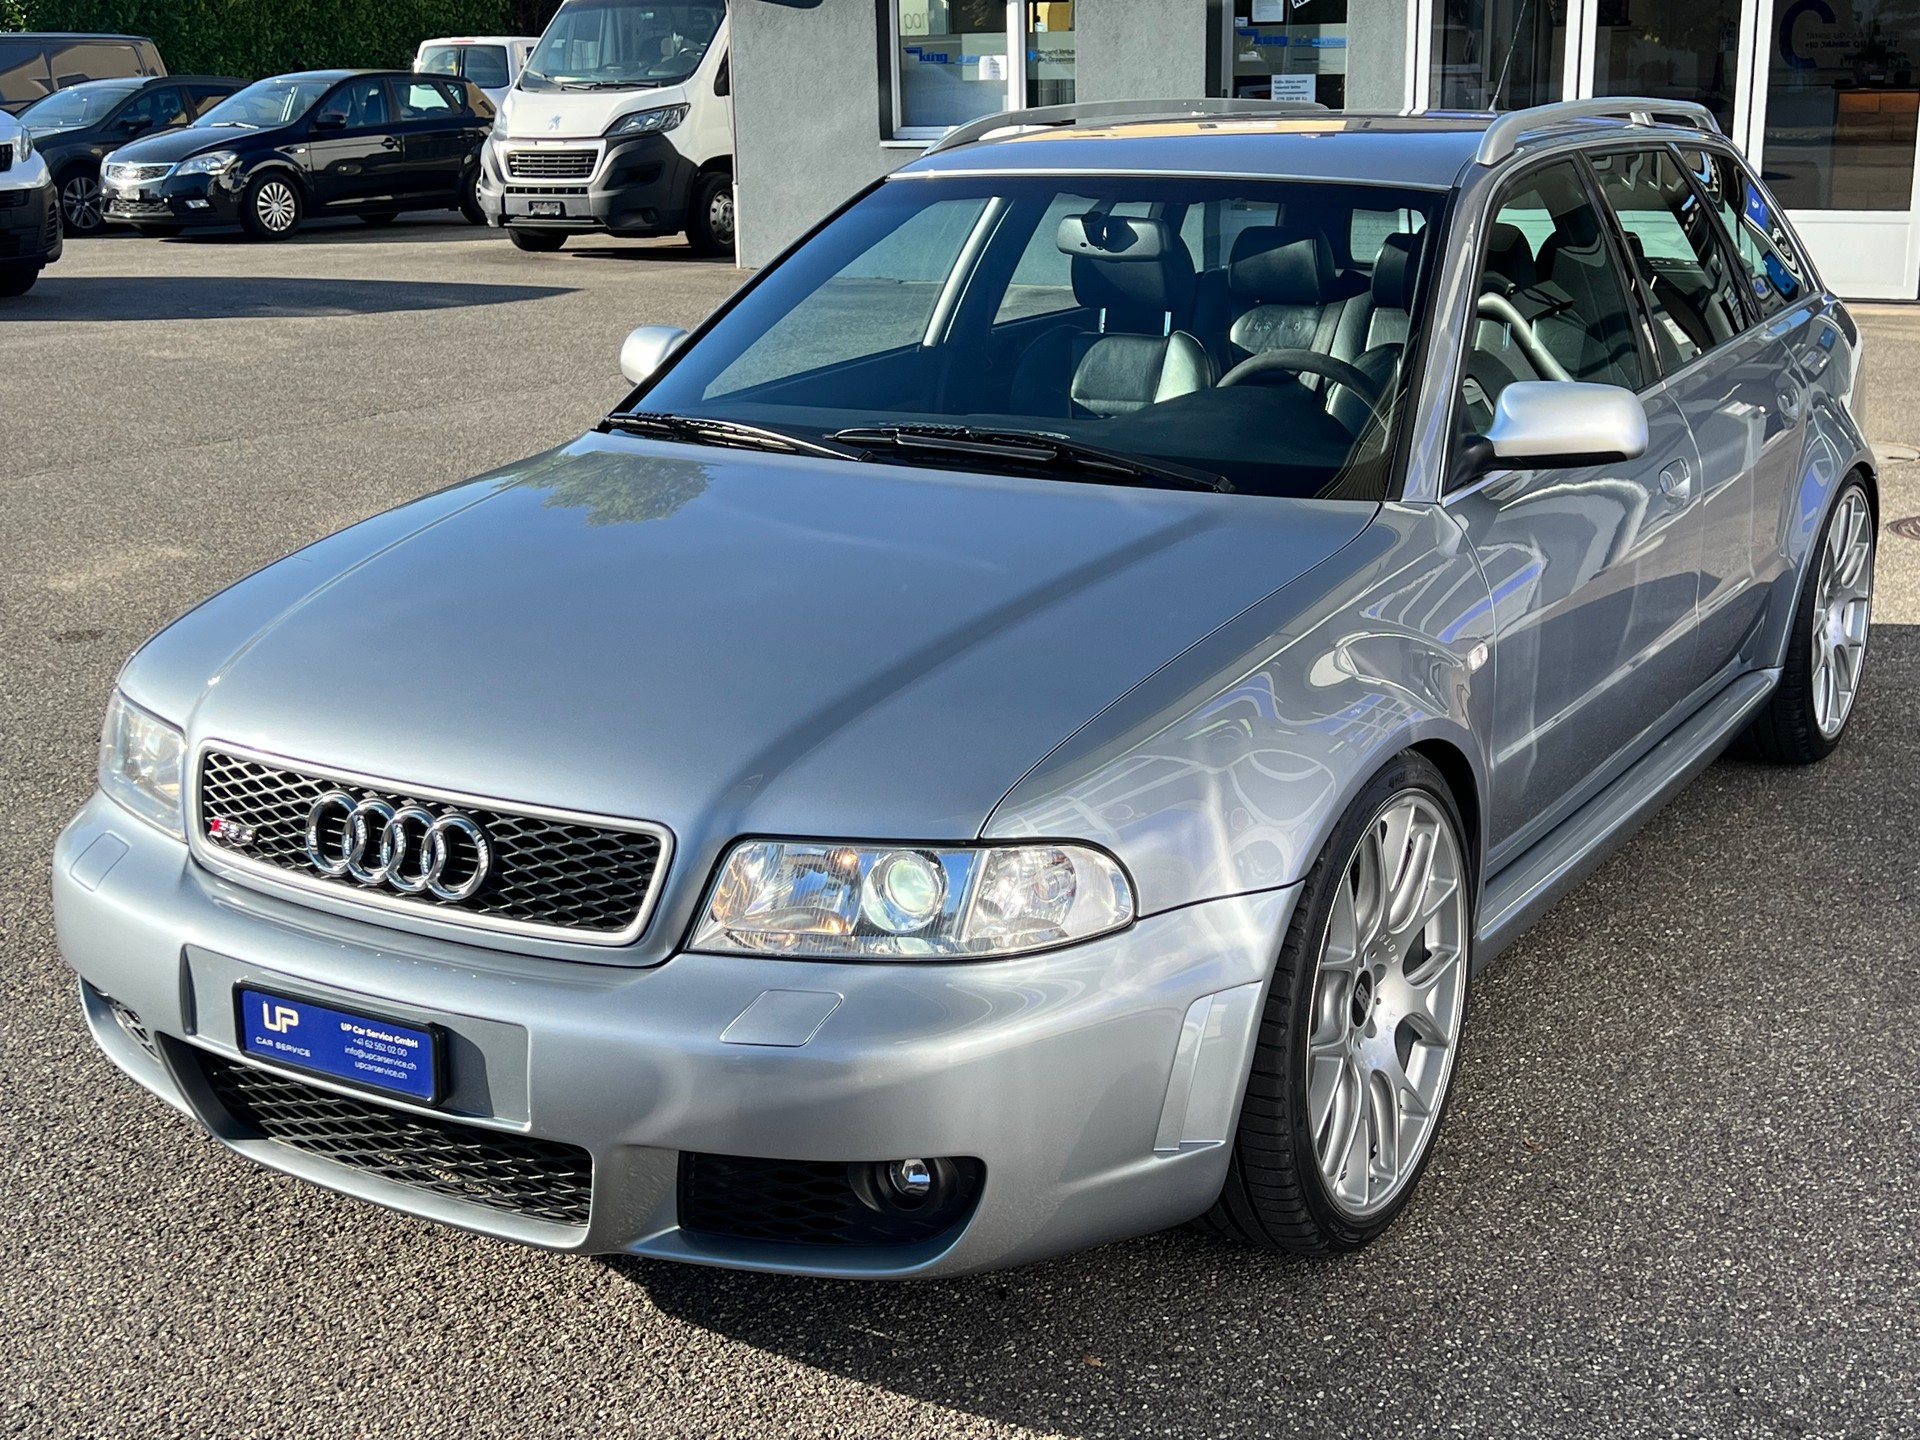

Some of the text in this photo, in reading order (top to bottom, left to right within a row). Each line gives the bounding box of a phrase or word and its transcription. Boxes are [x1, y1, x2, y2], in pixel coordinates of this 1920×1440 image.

[262, 1000, 299, 1034] UP
[255, 1036, 311, 1058] CAR SERVICE
[340, 1021, 419, 1049] UP Car Service GmbH
[344, 1045, 418, 1071] info@upcarservice.ch
[352, 1037, 364, 1047] +41
[364, 1039, 374, 1049] 62
[386, 1044, 397, 1055] 02
[397, 1047, 408, 1058] 00
[354, 1060, 408, 1080] upcarservice.ch
